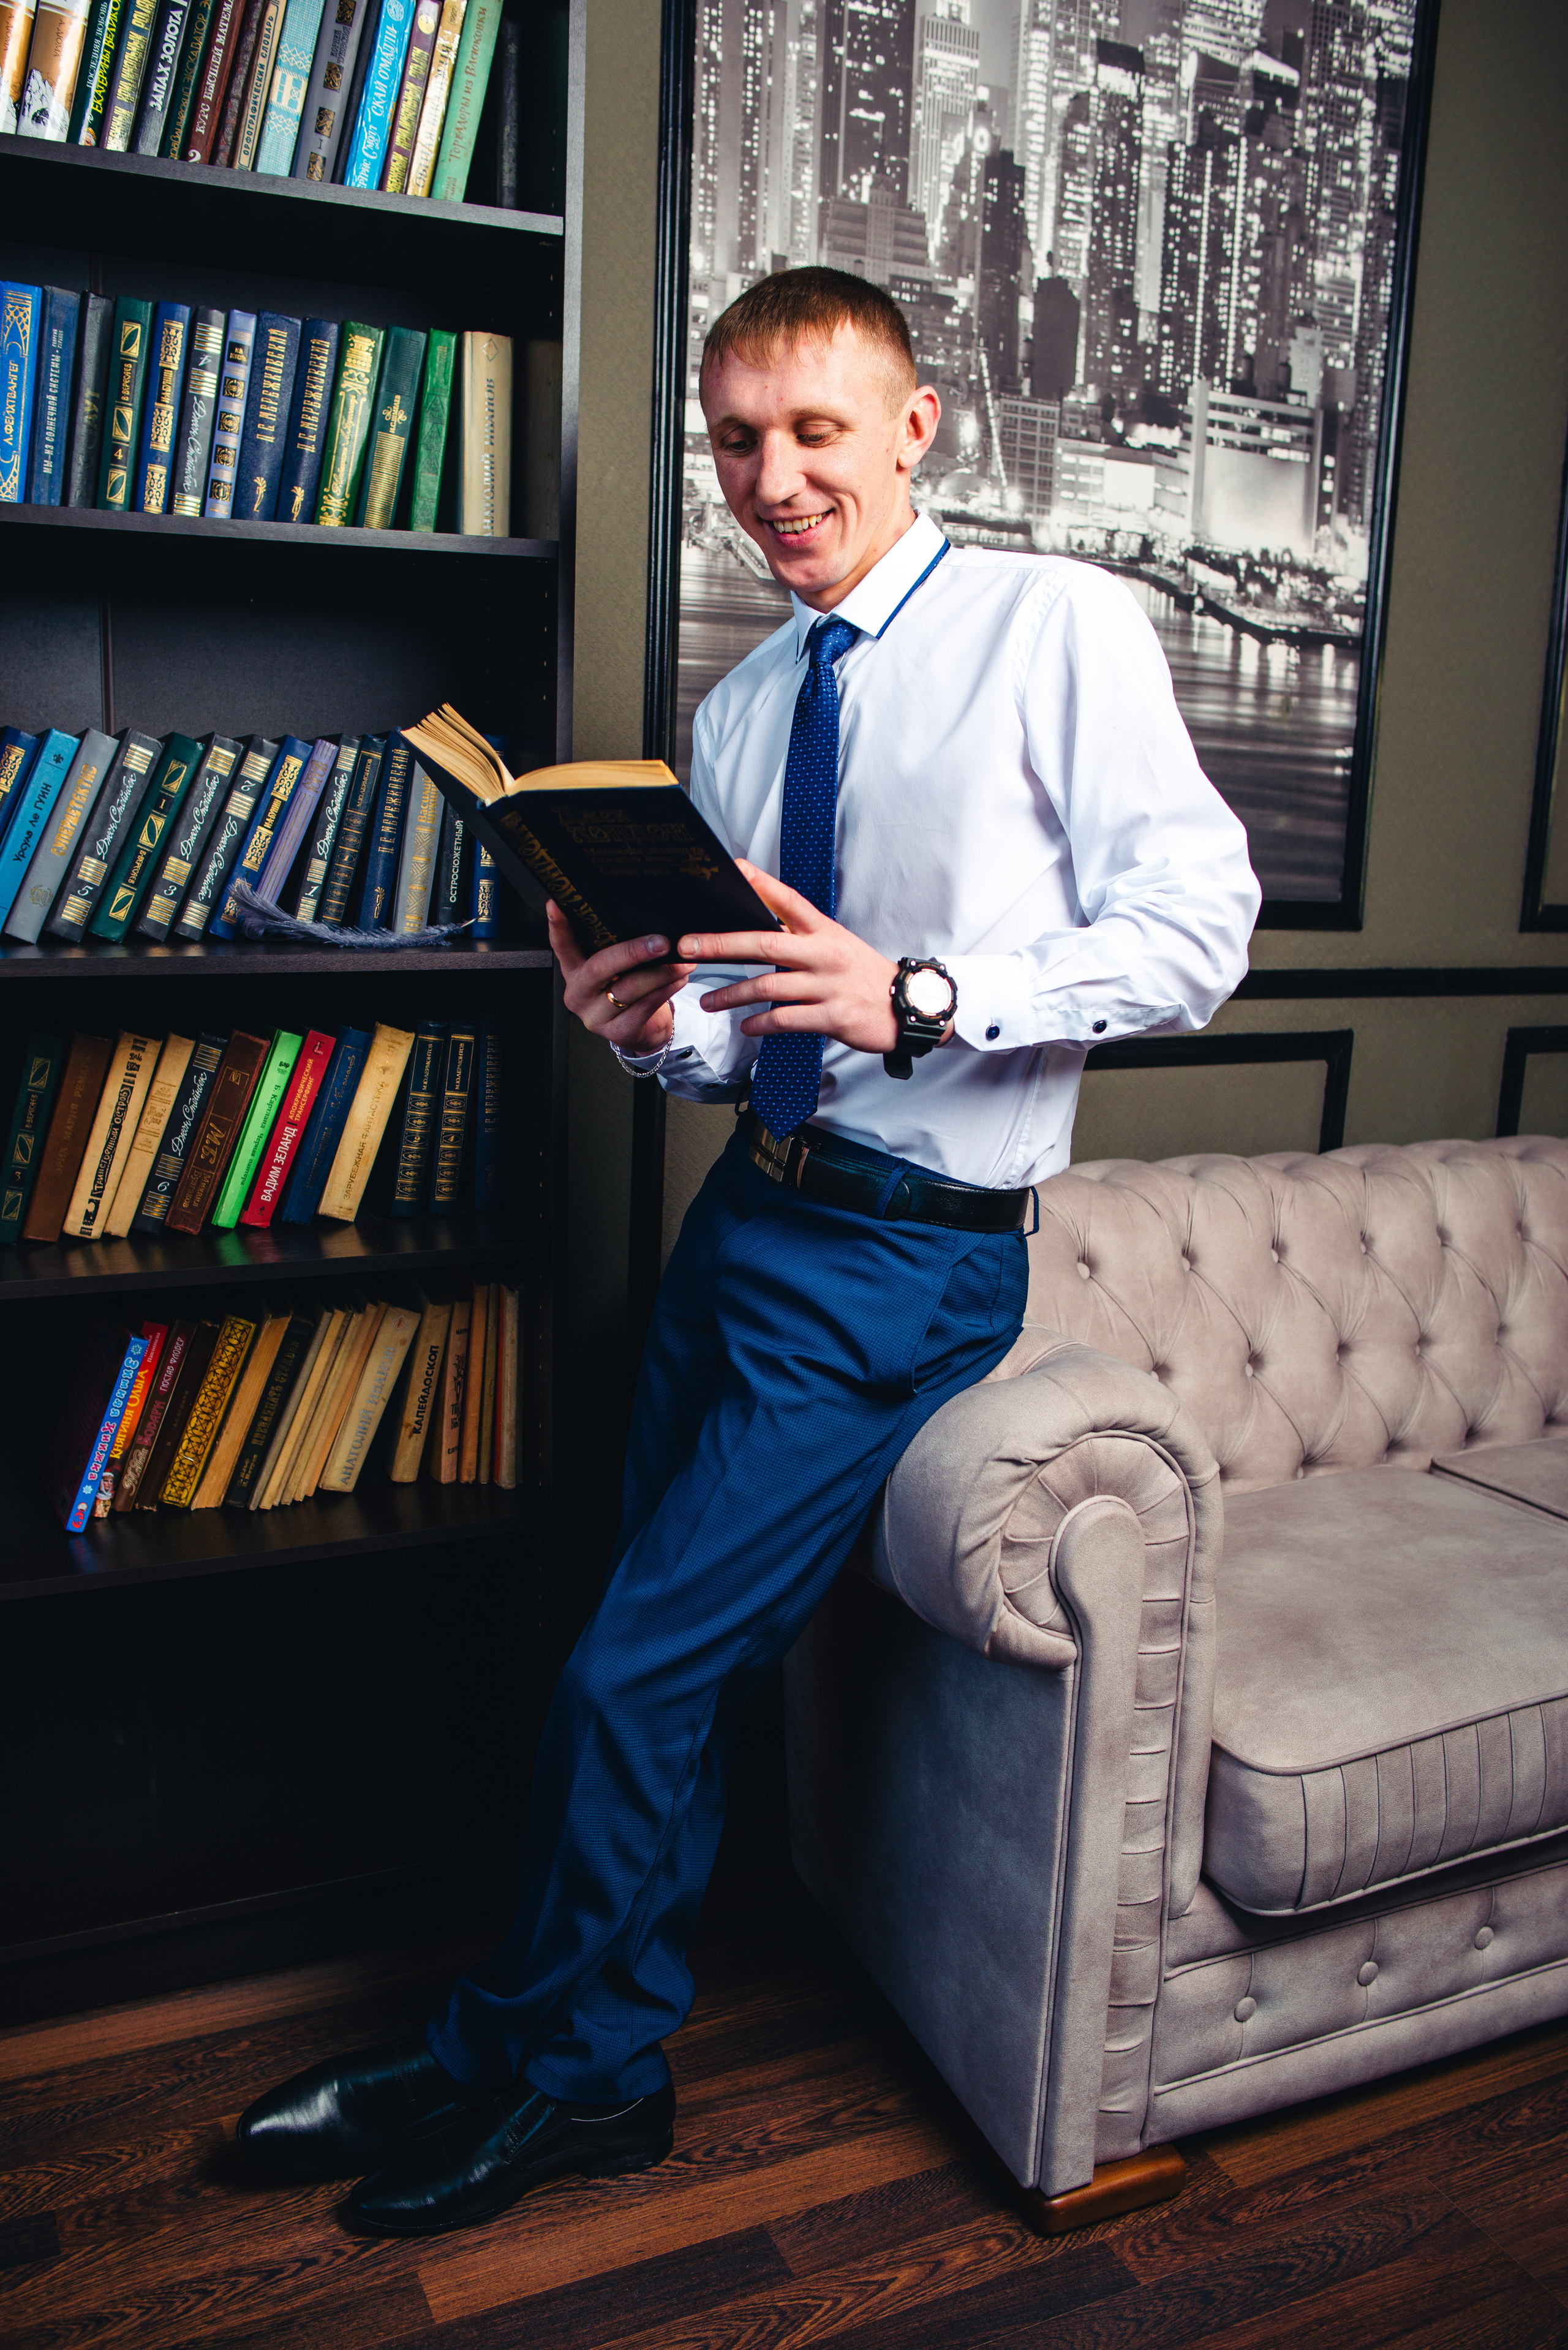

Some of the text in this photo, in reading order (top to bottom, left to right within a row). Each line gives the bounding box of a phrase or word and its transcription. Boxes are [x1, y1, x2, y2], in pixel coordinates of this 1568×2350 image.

[4, 21, 13, 51] ДЮМА
[54, 27, 64, 58] ДЮМА
[86, 2, 108, 88] ПОСЛЕДНЯЯ ЛЮБОВЬ
[92, 0, 123, 114] ЕКАТЕРИНЫ ВЕЛИКО
[160, 9, 184, 64] ЗОЛОТА
[183, 13, 208, 85] ЭКСКАВАТОР
[330, 29, 342, 58] КОРНЕЙ
[337, 26, 352, 64] ЧУКОВСКИЙ
[407, 45, 430, 81] РОМАН
[116, 31, 148, 105] КРИМИНАЛЬНЫЙ
[150, 62, 171, 111] ЗАПАХ
[195, 102, 211, 135] КУРС
[203, 45, 224, 102] ВЫСШЕЙ
[243, 15, 274, 156] ОРФОГРАФИЧЕСКИЙ СЛОВАРЬ
[464, 80, 473, 94] из
[371, 78, 389, 117] СКАЙ
[394, 80, 424, 152] КРИМИНАЛЬНЫЙ
[106, 105, 135, 153] УБЕЖНЫЙ
[49, 354, 62, 394] СИСТЕМЫ
[198, 353, 212, 366] 4
[259, 328, 288, 421] МЕРЕЖКОВСКИЙ
[300, 339, 331, 431] МЕРЕЖКОВСКИЙ
[45, 395, 58, 442] СОЛНЕЧНОЙ
[484, 378, 496, 446] ИВАНОВ
[114, 448, 123, 460] 4
[183, 436, 202, 493] Стейнбек
[28, 814, 40, 828] Ле
[34, 782, 52, 811] ГУИН
[50, 763, 98, 857] СУПЕРДЕТЕКТИВ
[241, 780, 256, 792] 2
[381, 749, 410, 834] МЕРЕЖКОВСКИЙ
[418, 773, 432, 823] Василий
[96, 772, 137, 861] Джон Стейнбек
[180, 774, 221, 861] Джон Стейнбек
[317, 773, 348, 860] Джон Стейнбек
[551, 806, 633, 826] Джек
[565, 822, 695, 844] ЛОНДОН
[198, 816, 238, 902] Джон Стейнбек
[450, 820, 464, 904] ОСТРОСЮЖЕТНЫЙ
[78, 885, 94, 897] 5
[164, 886, 178, 896] 3
[305, 885, 319, 897] 1
[172, 1071, 208, 1157] Джон Стейнбек
[288, 1058, 314, 1120] АПОКРИФИЧЕСКИЙ
[295, 1078, 314, 1122] ТРАНСЕРФИНГ
[64, 1103, 79, 1141] МАРИЯ
[241, 1084, 281, 1187] Б. Картланд Черная пантера
[343, 1081, 386, 1201] ЗАРУБЕЖНАЯ ФАНТАСТИКА
[15, 1171, 21, 1182] 3
[157, 1181, 170, 1192] 6
[183, 1169, 203, 1208] Булгаков
[193, 1172, 211, 1209] Михаил
[261, 1126, 298, 1202] ВАДИМ ЗЕЛАНД
[160, 1336, 184, 1392] ГЮСТАВ ФЛОБЕР
[88, 1356, 140, 1481] Зимняя Книжка
[110, 1369, 149, 1460] КНЯГИНЯ ОЛЬГА
[136, 1400, 165, 1446] БОВАРИ
[252, 1385, 283, 1447] ДВЕНАДЦАТЬ
[339, 1345, 397, 1486] АНАТОЛИЙ ИВАНОВ
